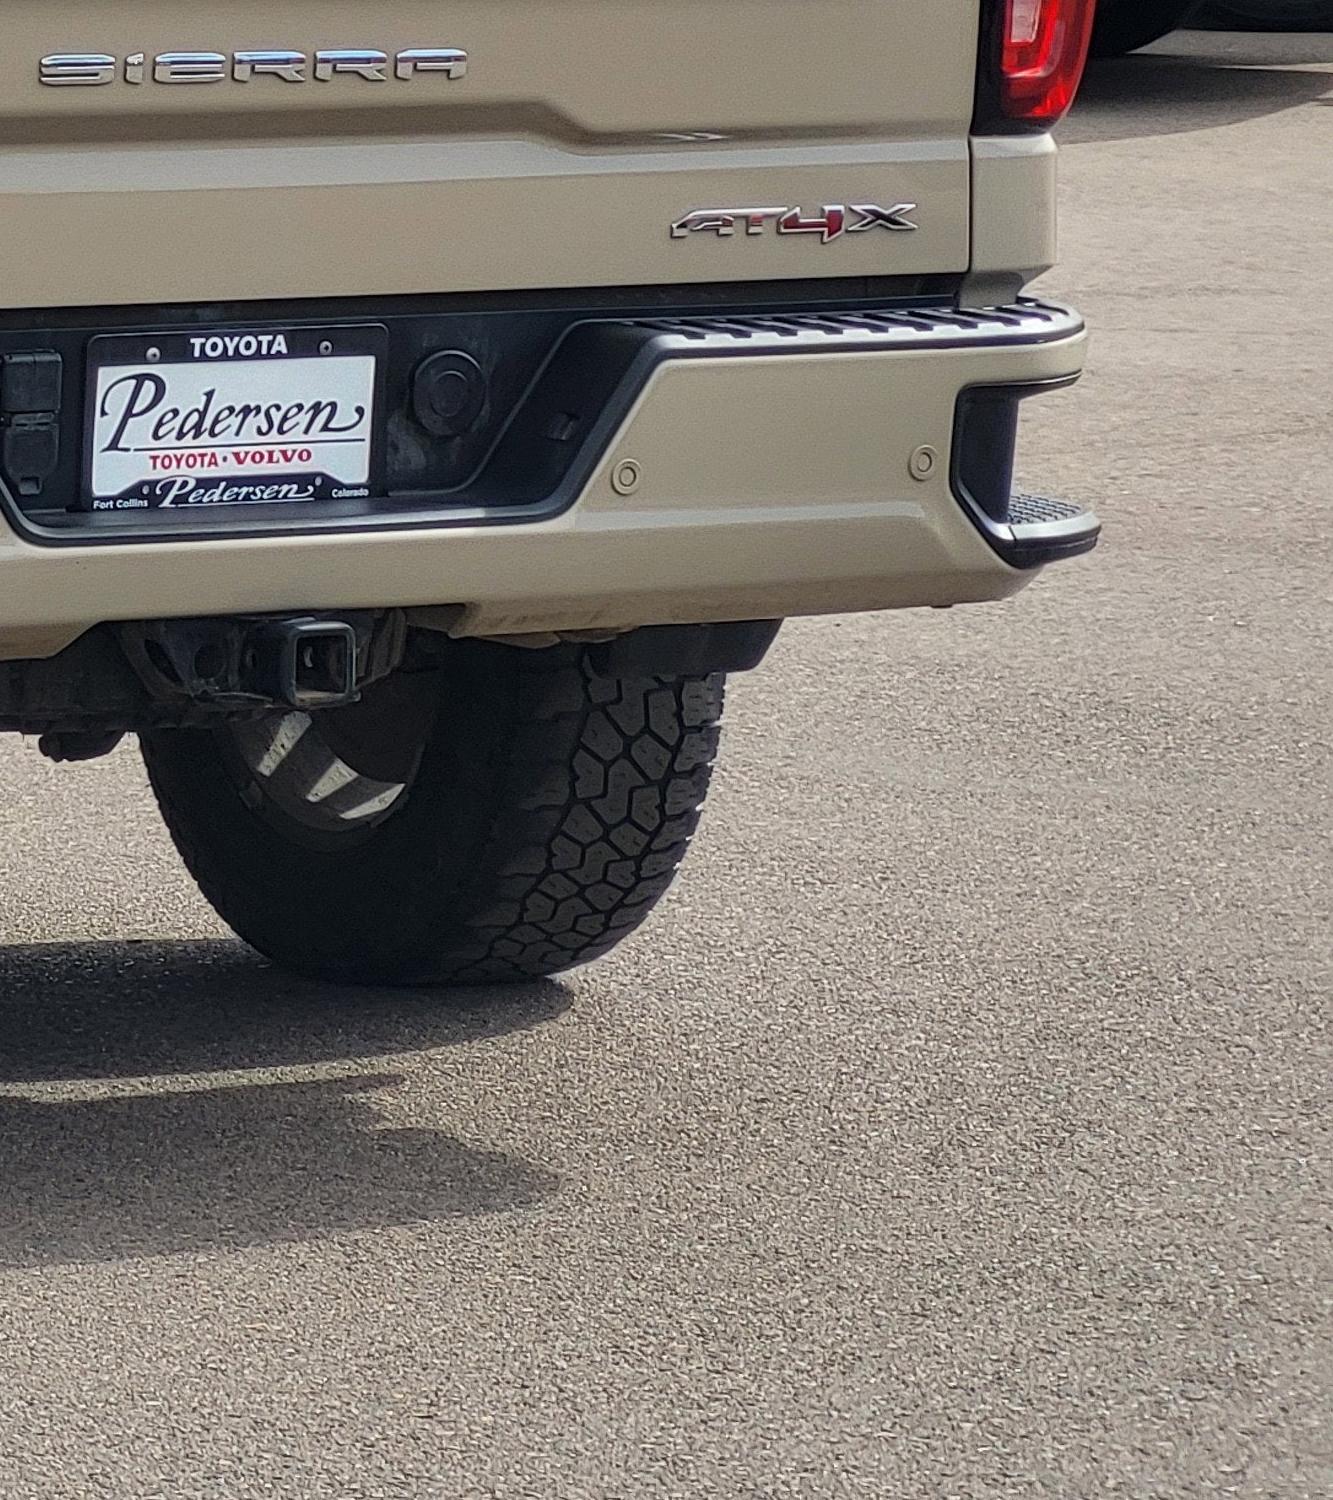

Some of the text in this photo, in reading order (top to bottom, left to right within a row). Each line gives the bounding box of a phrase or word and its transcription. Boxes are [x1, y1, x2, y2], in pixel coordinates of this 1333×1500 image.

[670, 203, 919, 244] AT4X
[190, 335, 288, 358] TOYOTA
[99, 372, 365, 453] Pedersen
[149, 449, 312, 470] TOYOTA VOLVO
[155, 475, 315, 508] Pedersen
[331, 487, 370, 498] Colorado
[93, 498, 148, 509] Fort Collins
